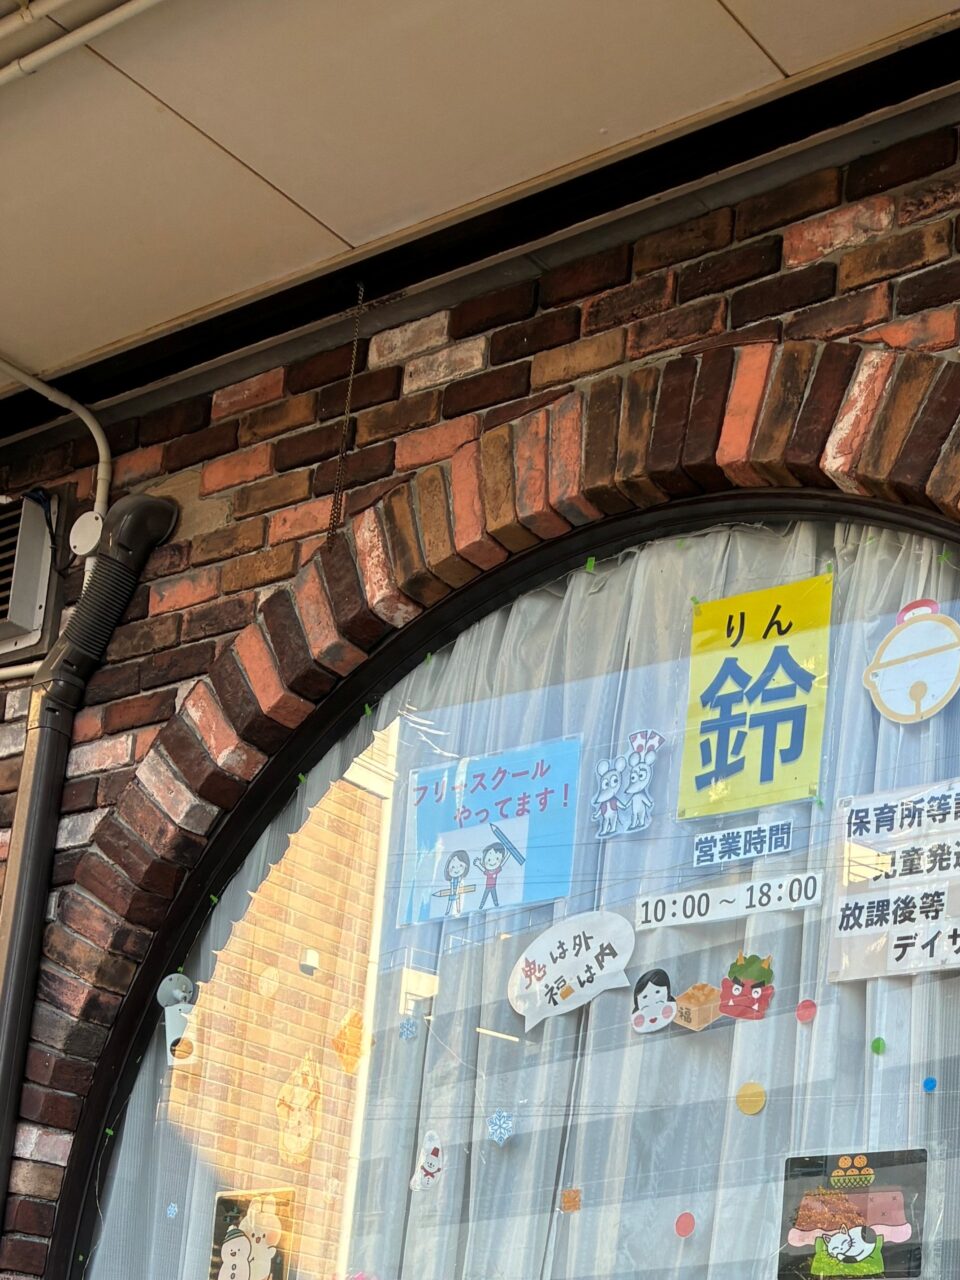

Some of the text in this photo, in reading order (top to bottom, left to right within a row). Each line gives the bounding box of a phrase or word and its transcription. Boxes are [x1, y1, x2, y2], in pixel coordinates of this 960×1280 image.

[726, 604, 793, 647] りん
[695, 645, 816, 792] 鈴
[413, 759, 551, 806] フリースクール
[453, 783, 569, 829] やってます！
[695, 821, 793, 865] 営業時間
[839, 890, 946, 932] 放課後等
[521, 930, 595, 990] 鬼は外
[678, 1006, 693, 1024] 福
